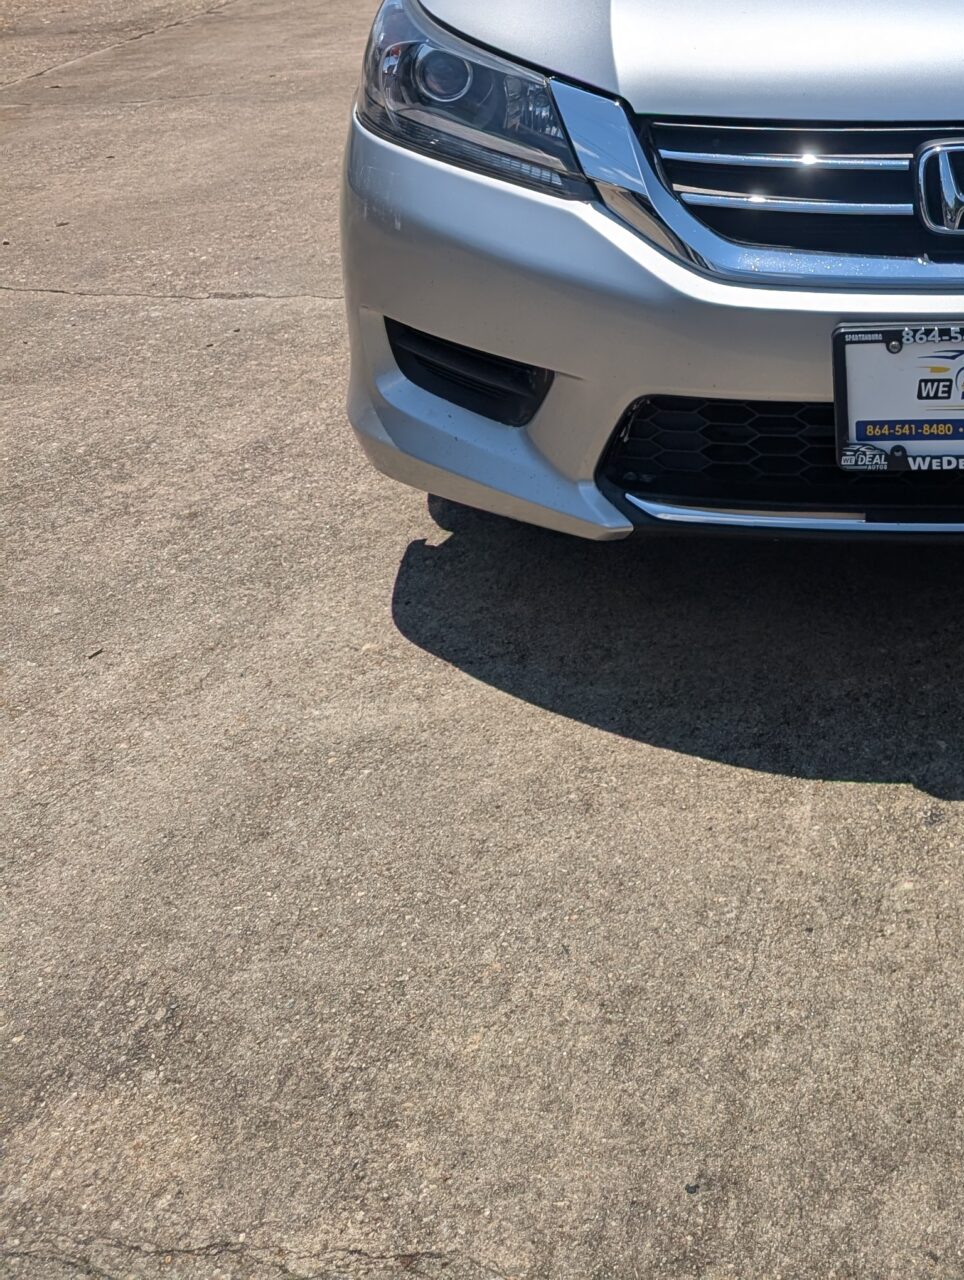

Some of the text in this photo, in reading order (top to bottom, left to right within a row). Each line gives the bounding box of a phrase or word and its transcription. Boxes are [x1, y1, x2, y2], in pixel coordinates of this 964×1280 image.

[920, 381, 950, 398] WE
[866, 424, 953, 436] 864-541-8480
[858, 454, 888, 465] DEAL
